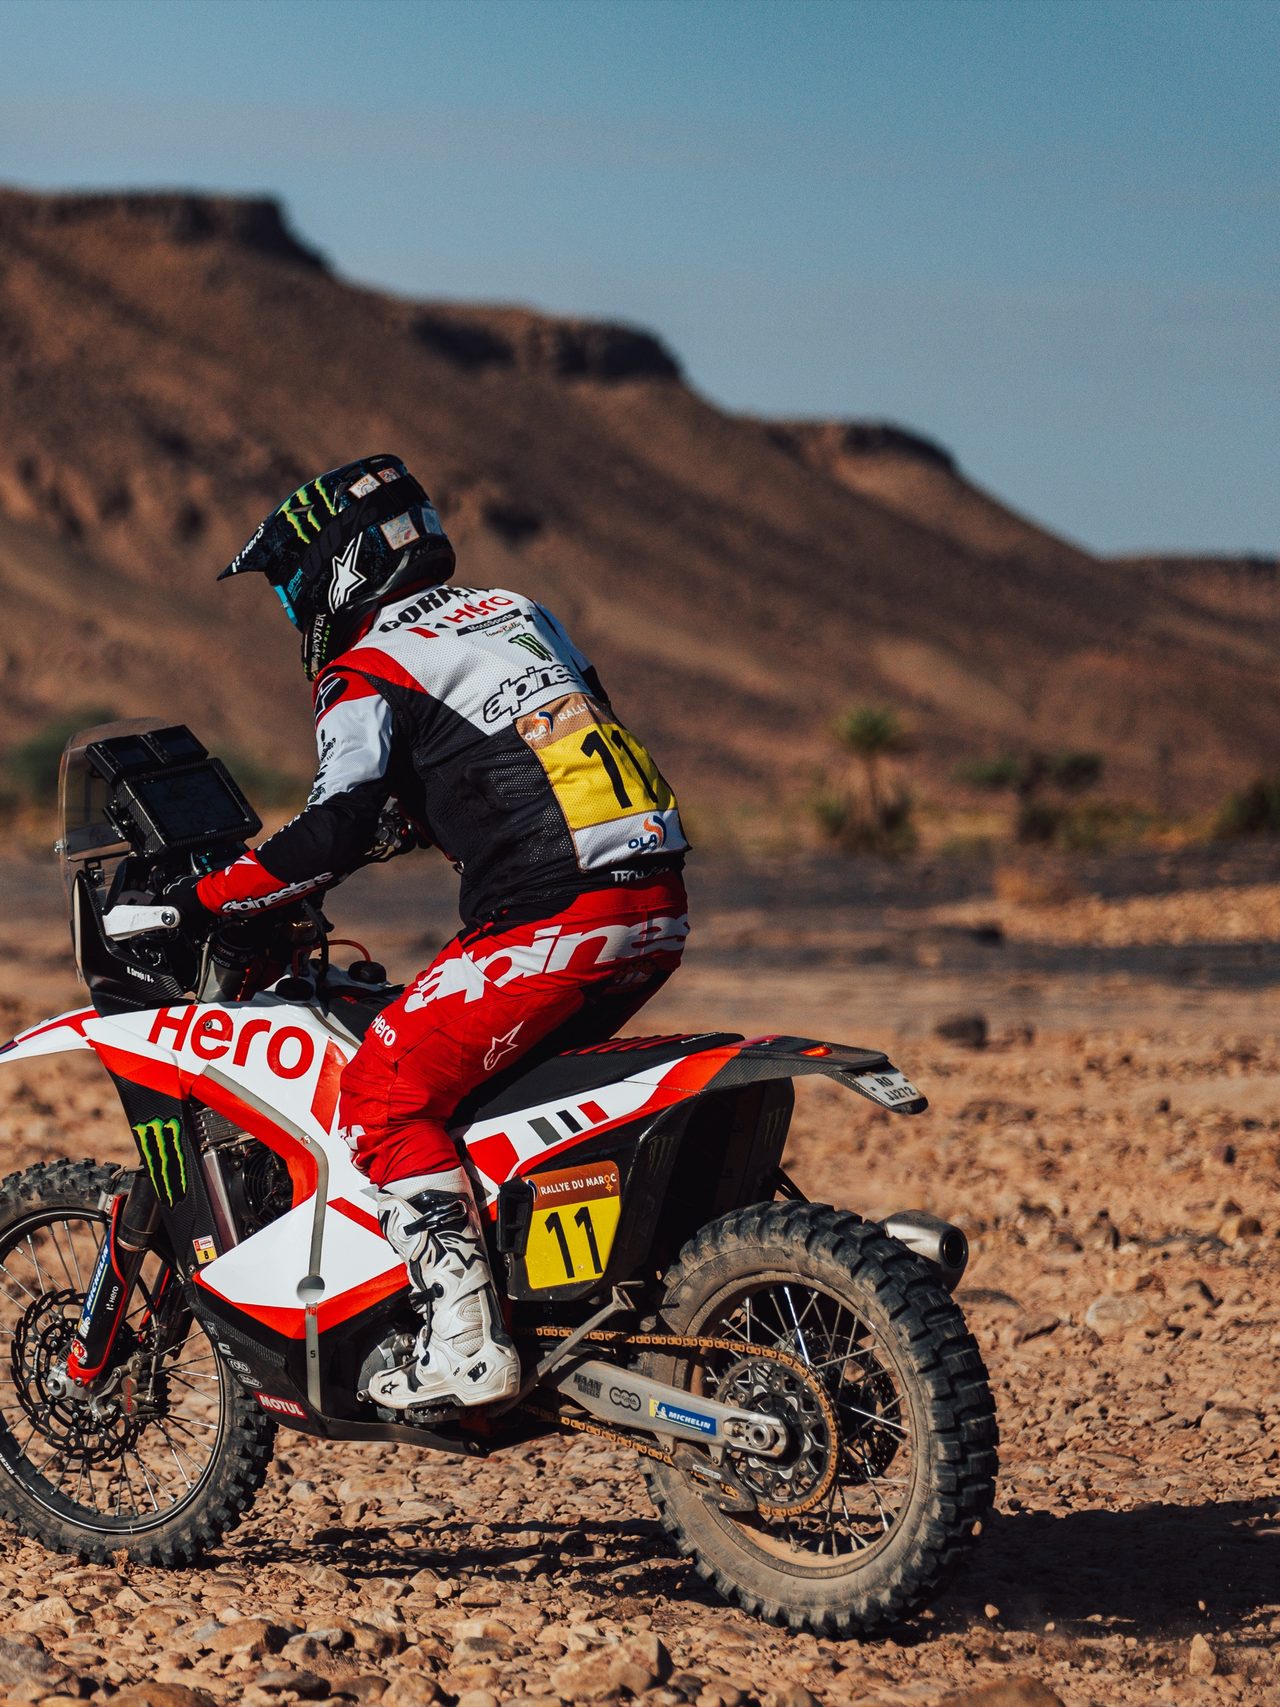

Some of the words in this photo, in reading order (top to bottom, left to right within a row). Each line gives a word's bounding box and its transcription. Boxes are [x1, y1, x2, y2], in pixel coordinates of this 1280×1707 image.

[442, 595, 513, 624] Hero
[581, 730, 659, 810] 11
[628, 834, 658, 849] OLA
[221, 871, 335, 913] alpinestars
[148, 1005, 315, 1080] Hero
[371, 1015, 396, 1046] Hero
[540, 1183, 570, 1195] RALLYE
[572, 1180, 584, 1190] DU
[586, 1173, 617, 1188] MAROC
[203, 1250, 210, 1260] 8
[545, 1206, 603, 1279] 11
[86, 1244, 109, 1311] MICHELIN
[110, 1285, 119, 1304] Hero
[310, 1350, 316, 1358] 5
[258, 1395, 304, 1416] MOTUL
[669, 1411, 711, 1430] MICHELIN
